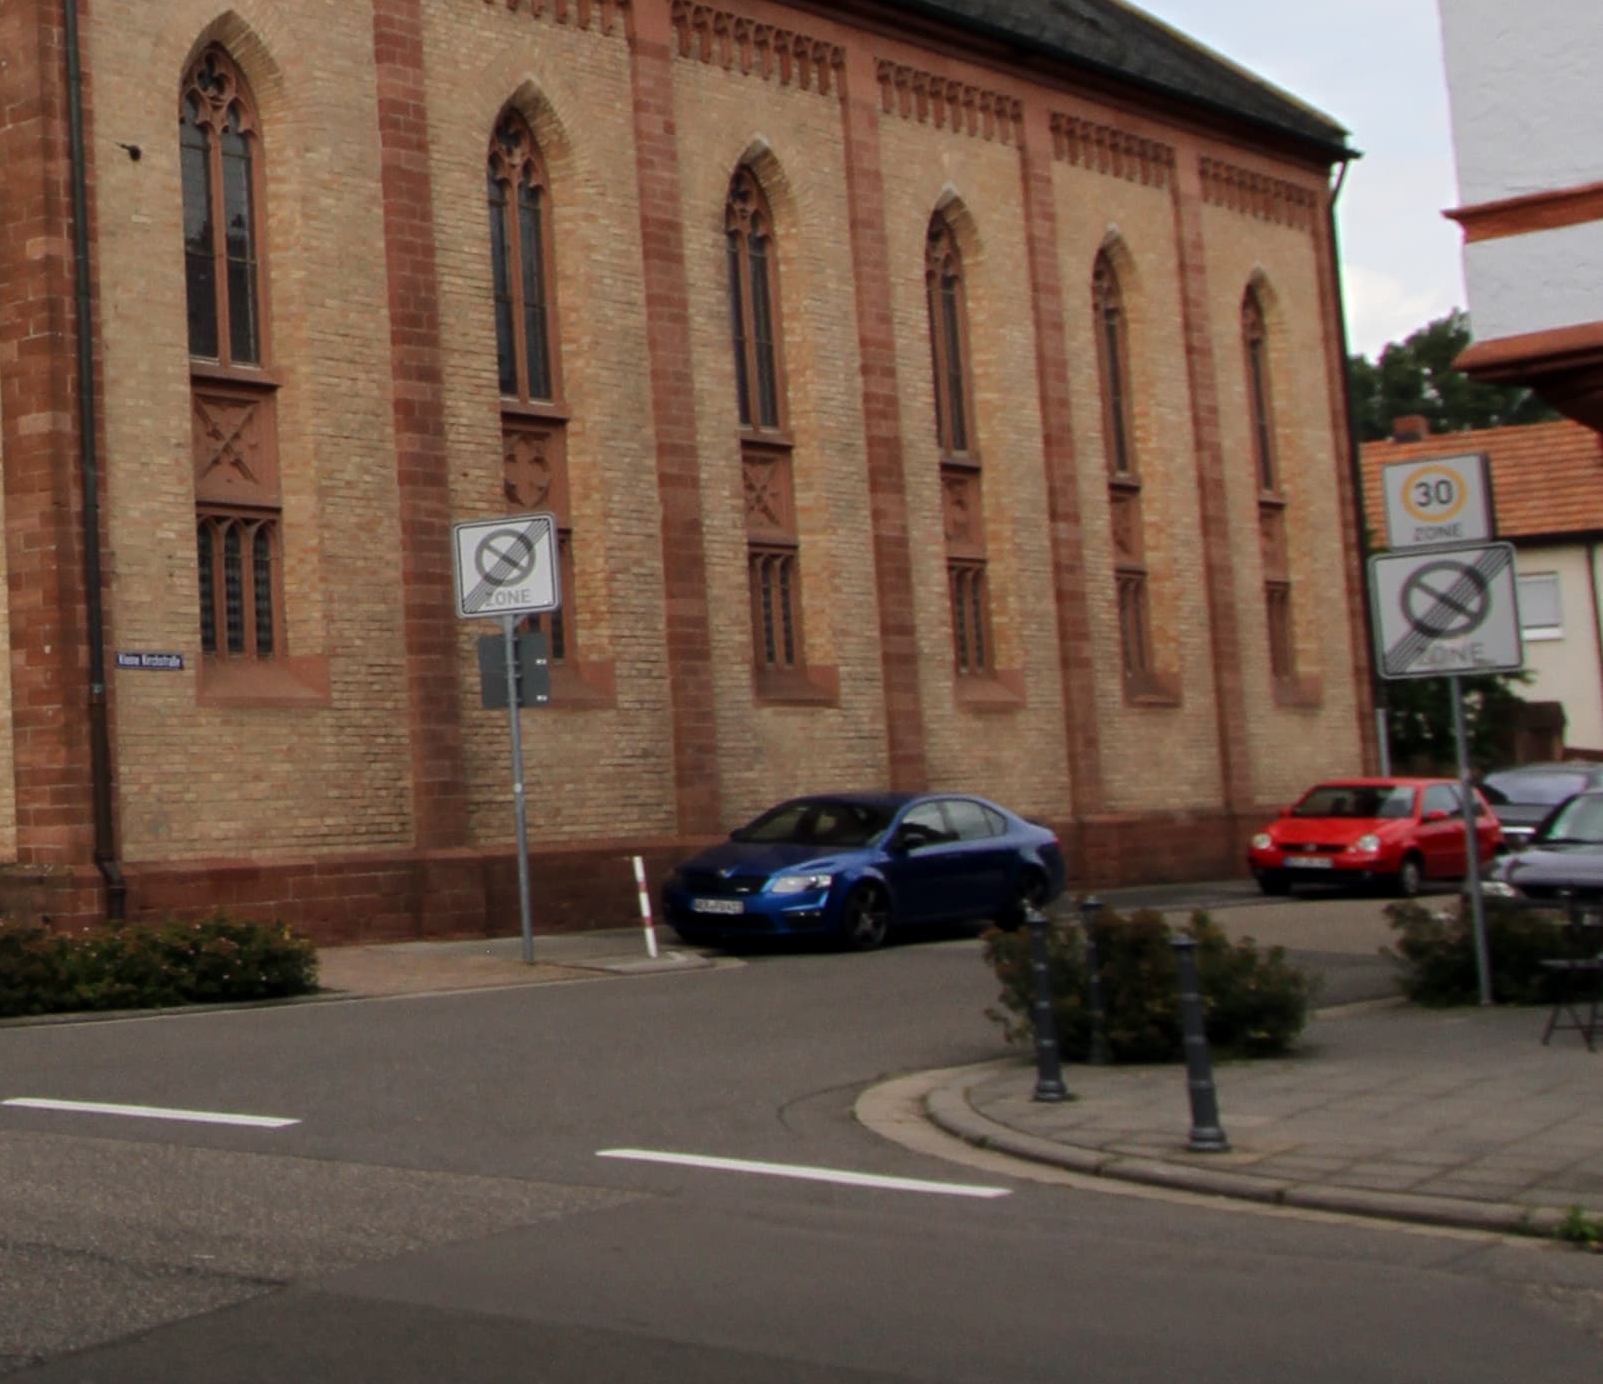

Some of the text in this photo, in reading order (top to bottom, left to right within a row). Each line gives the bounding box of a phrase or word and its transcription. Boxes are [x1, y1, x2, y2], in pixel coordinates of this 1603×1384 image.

[1414, 480, 1454, 508] 30
[1413, 523, 1463, 542] ZONE
[485, 589, 531, 607] ZONE
[1415, 642, 1484, 668] ZONE
